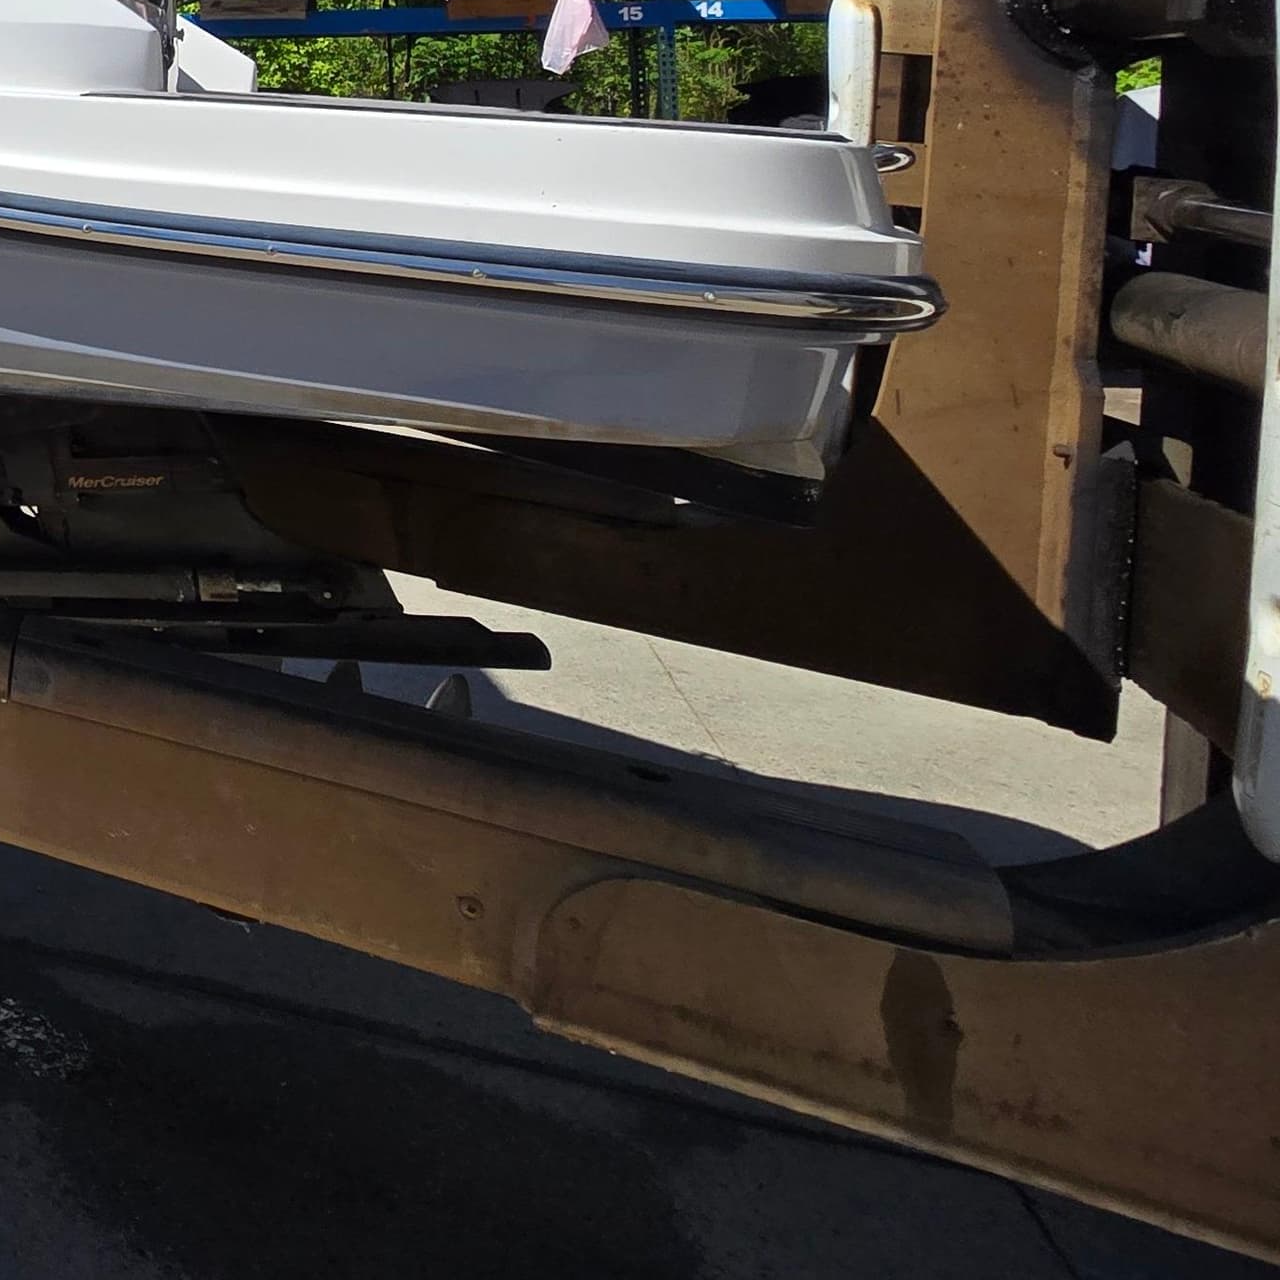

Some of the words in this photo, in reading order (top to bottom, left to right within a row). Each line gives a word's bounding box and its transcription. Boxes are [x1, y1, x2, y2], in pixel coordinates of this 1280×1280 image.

[618, 6, 643, 21] 15
[696, 1, 724, 18] 14
[68, 476, 164, 488] MerCruiser
